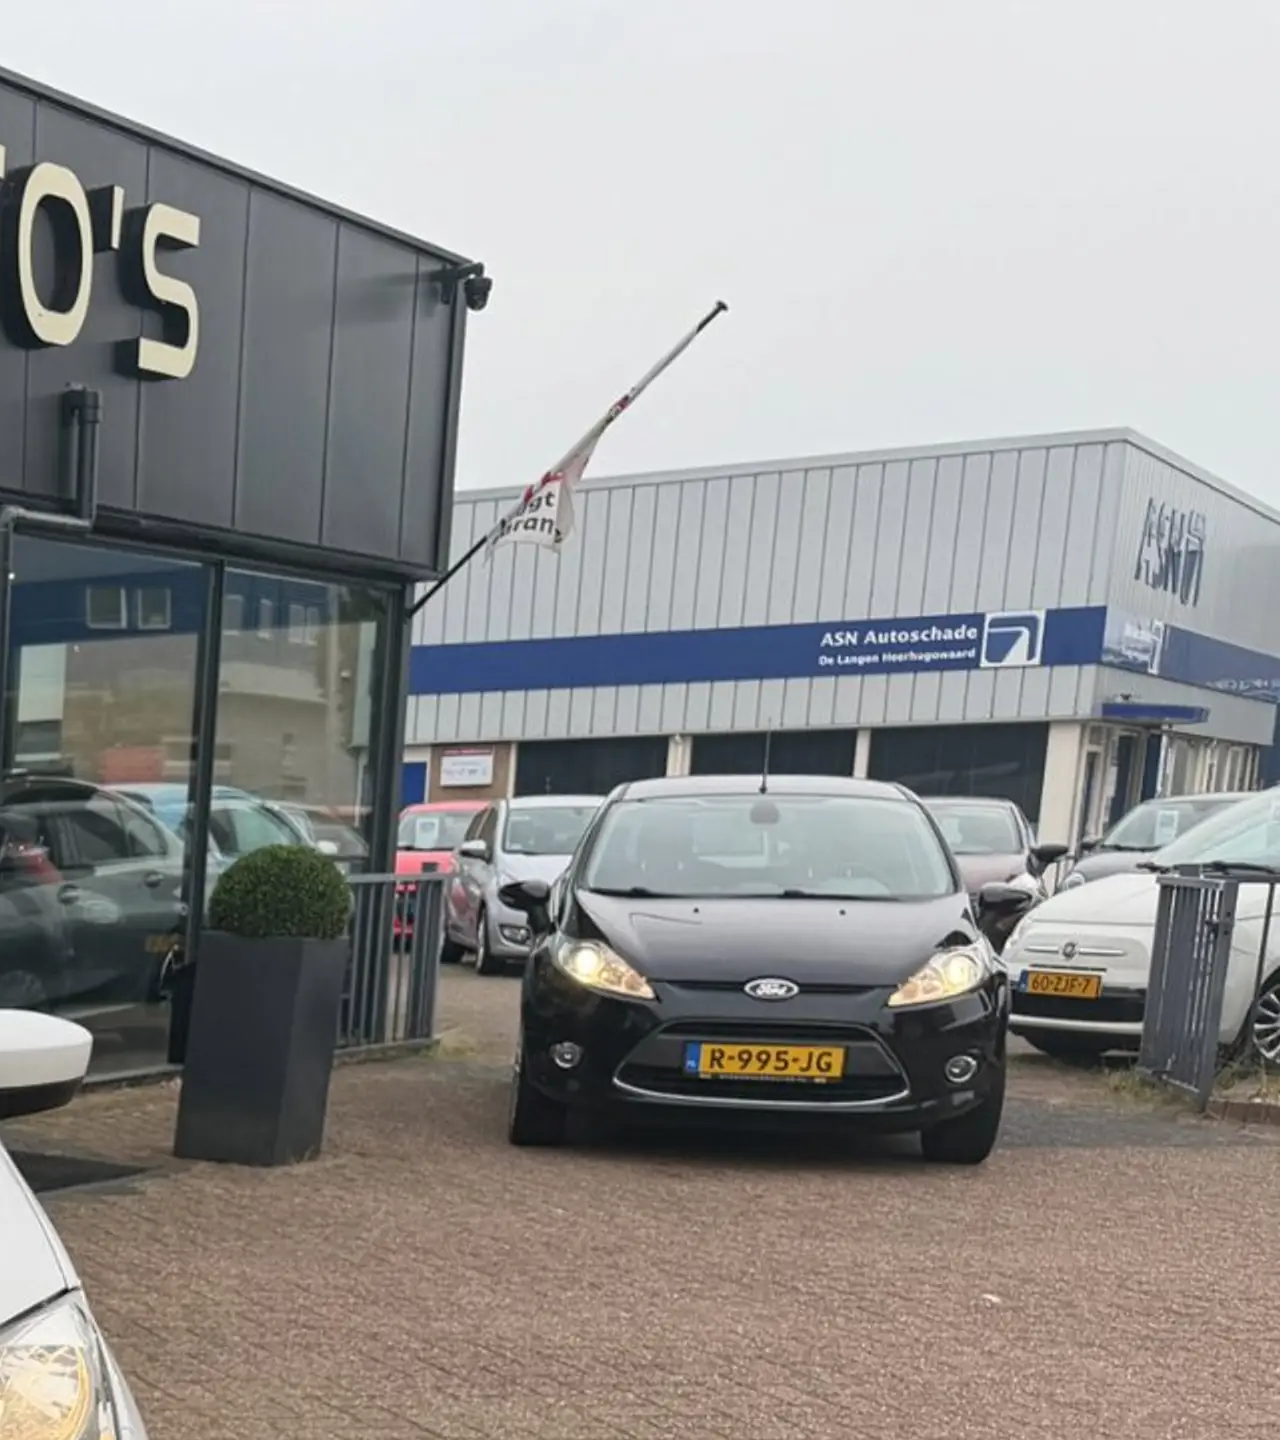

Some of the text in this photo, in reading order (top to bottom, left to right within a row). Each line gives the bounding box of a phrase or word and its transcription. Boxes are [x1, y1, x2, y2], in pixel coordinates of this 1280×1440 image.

[820, 624, 979, 648] ASN Autoschade
[818, 654, 835, 667] De
[836, 652, 879, 667] Langen
[708, 1047, 833, 1073] R-995-JG
